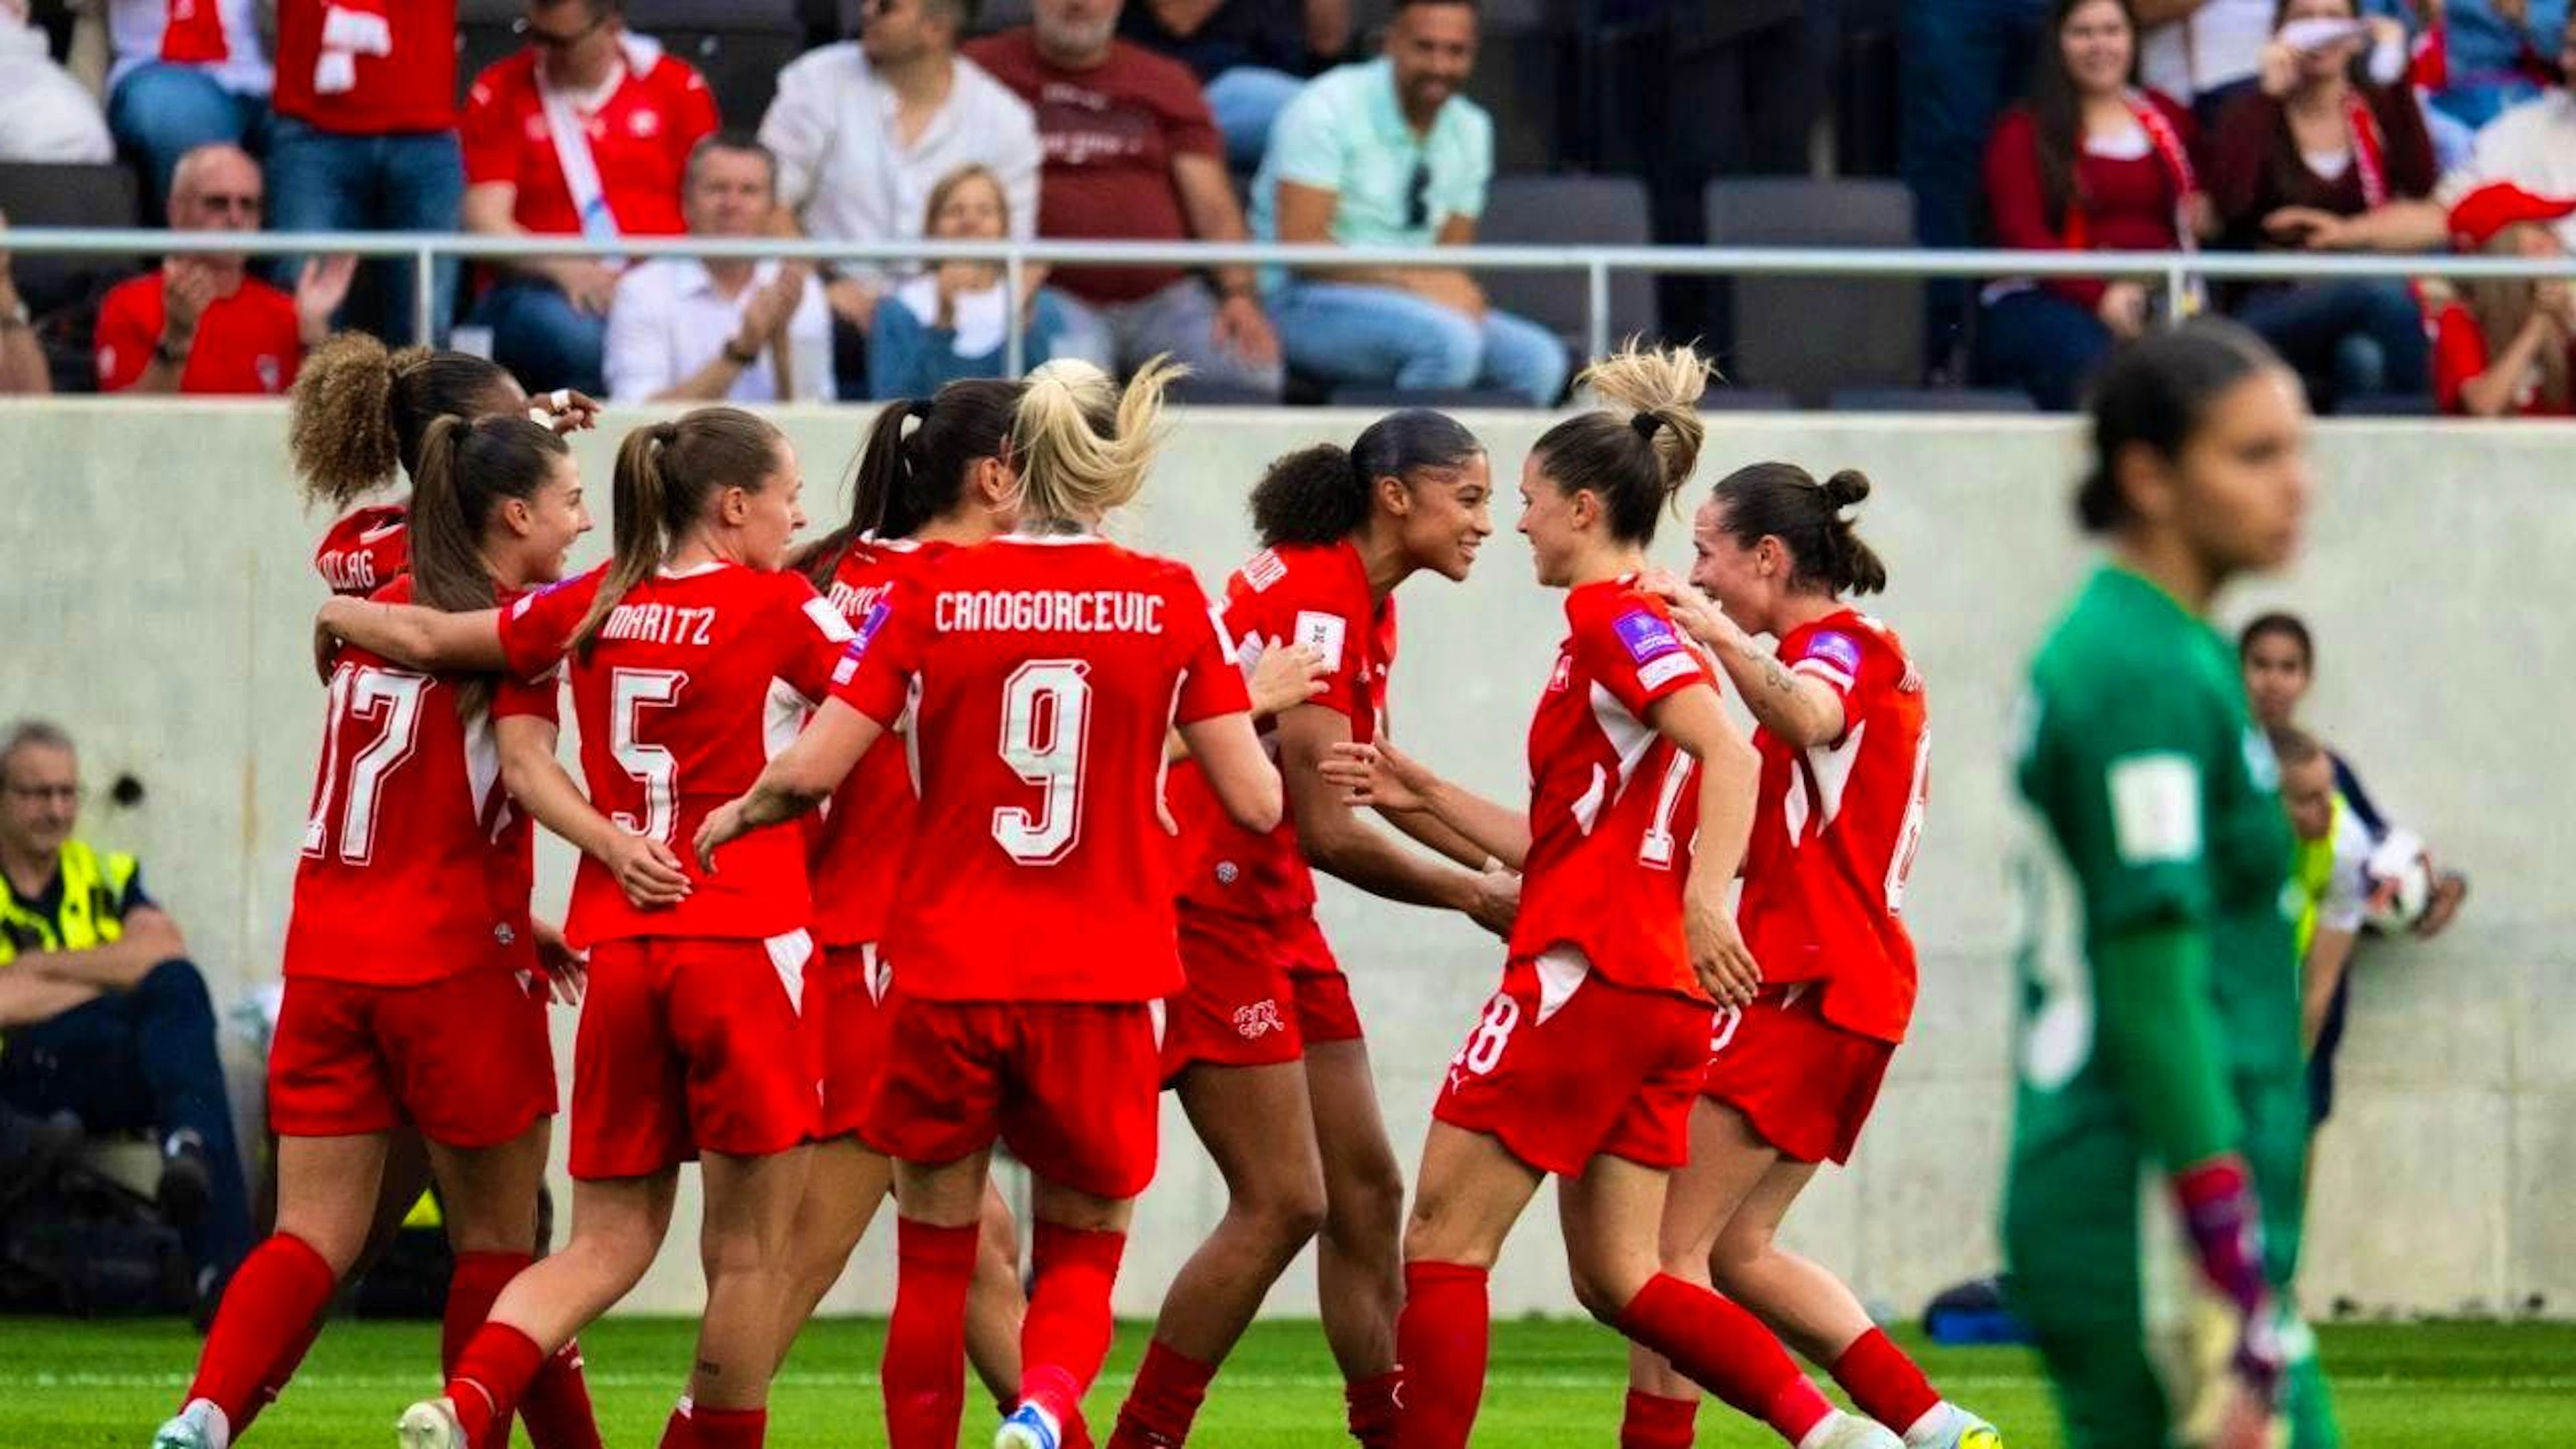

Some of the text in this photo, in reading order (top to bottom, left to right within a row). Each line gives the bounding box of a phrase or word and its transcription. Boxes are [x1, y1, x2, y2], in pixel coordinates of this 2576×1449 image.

[602, 603, 716, 645] MARITZ
[935, 590, 1165, 635] CRNOGORCEVIC
[301, 661, 437, 867] 17
[610, 667, 690, 847] 5
[991, 659, 1092, 866] 9
